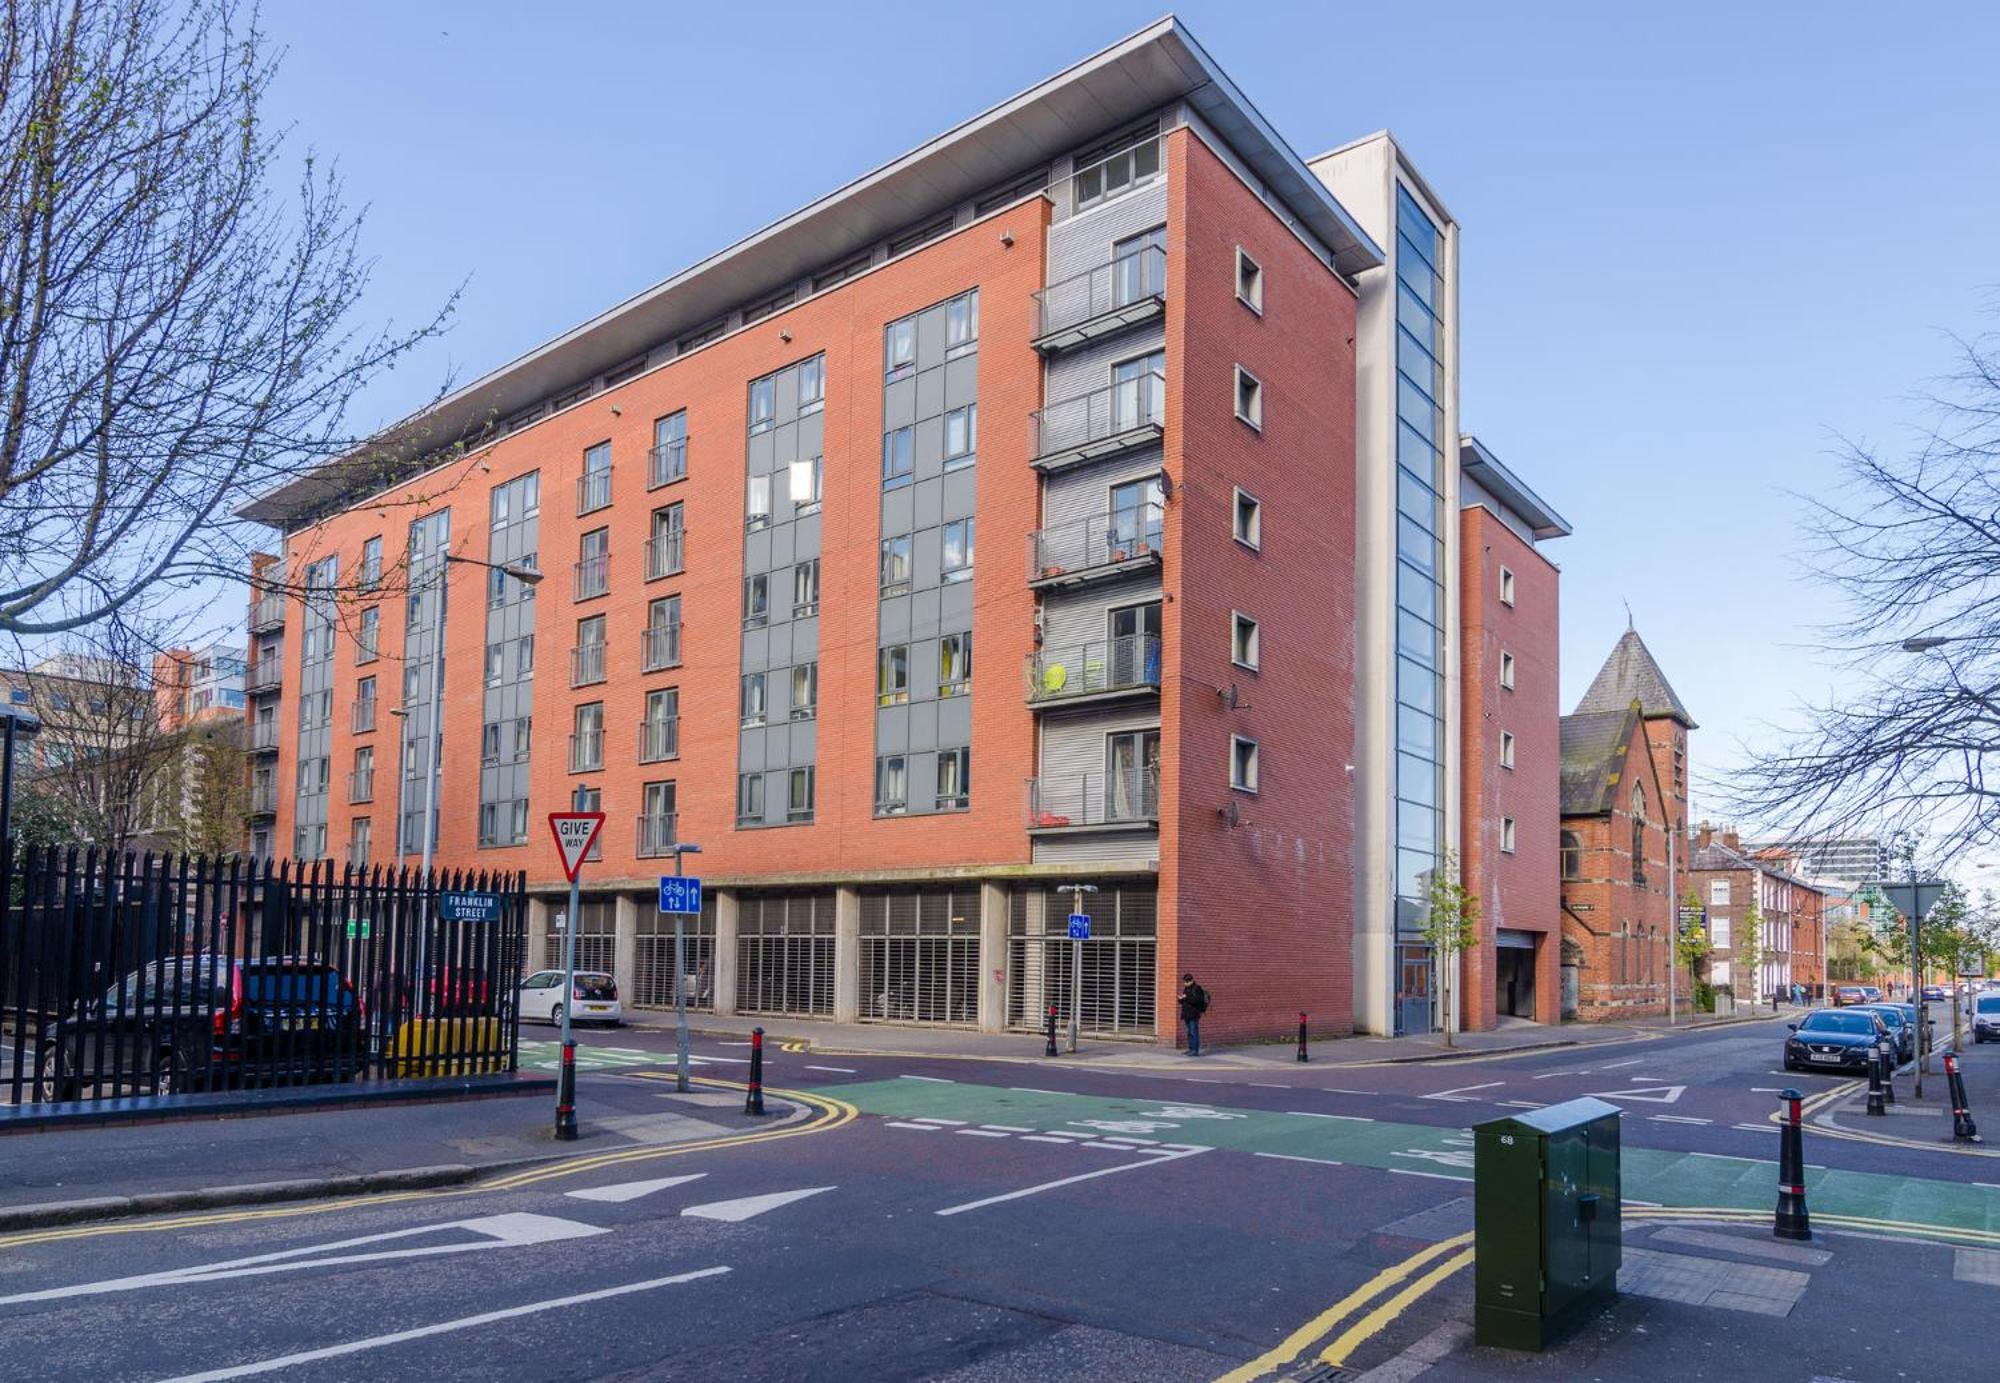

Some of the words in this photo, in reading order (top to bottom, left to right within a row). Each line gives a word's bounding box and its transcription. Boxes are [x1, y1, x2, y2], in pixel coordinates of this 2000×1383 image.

[560, 821, 590, 835] GIVE
[565, 838, 585, 848] WAY
[449, 895, 493, 907] FRANKLIN
[455, 907, 487, 918] STREET
